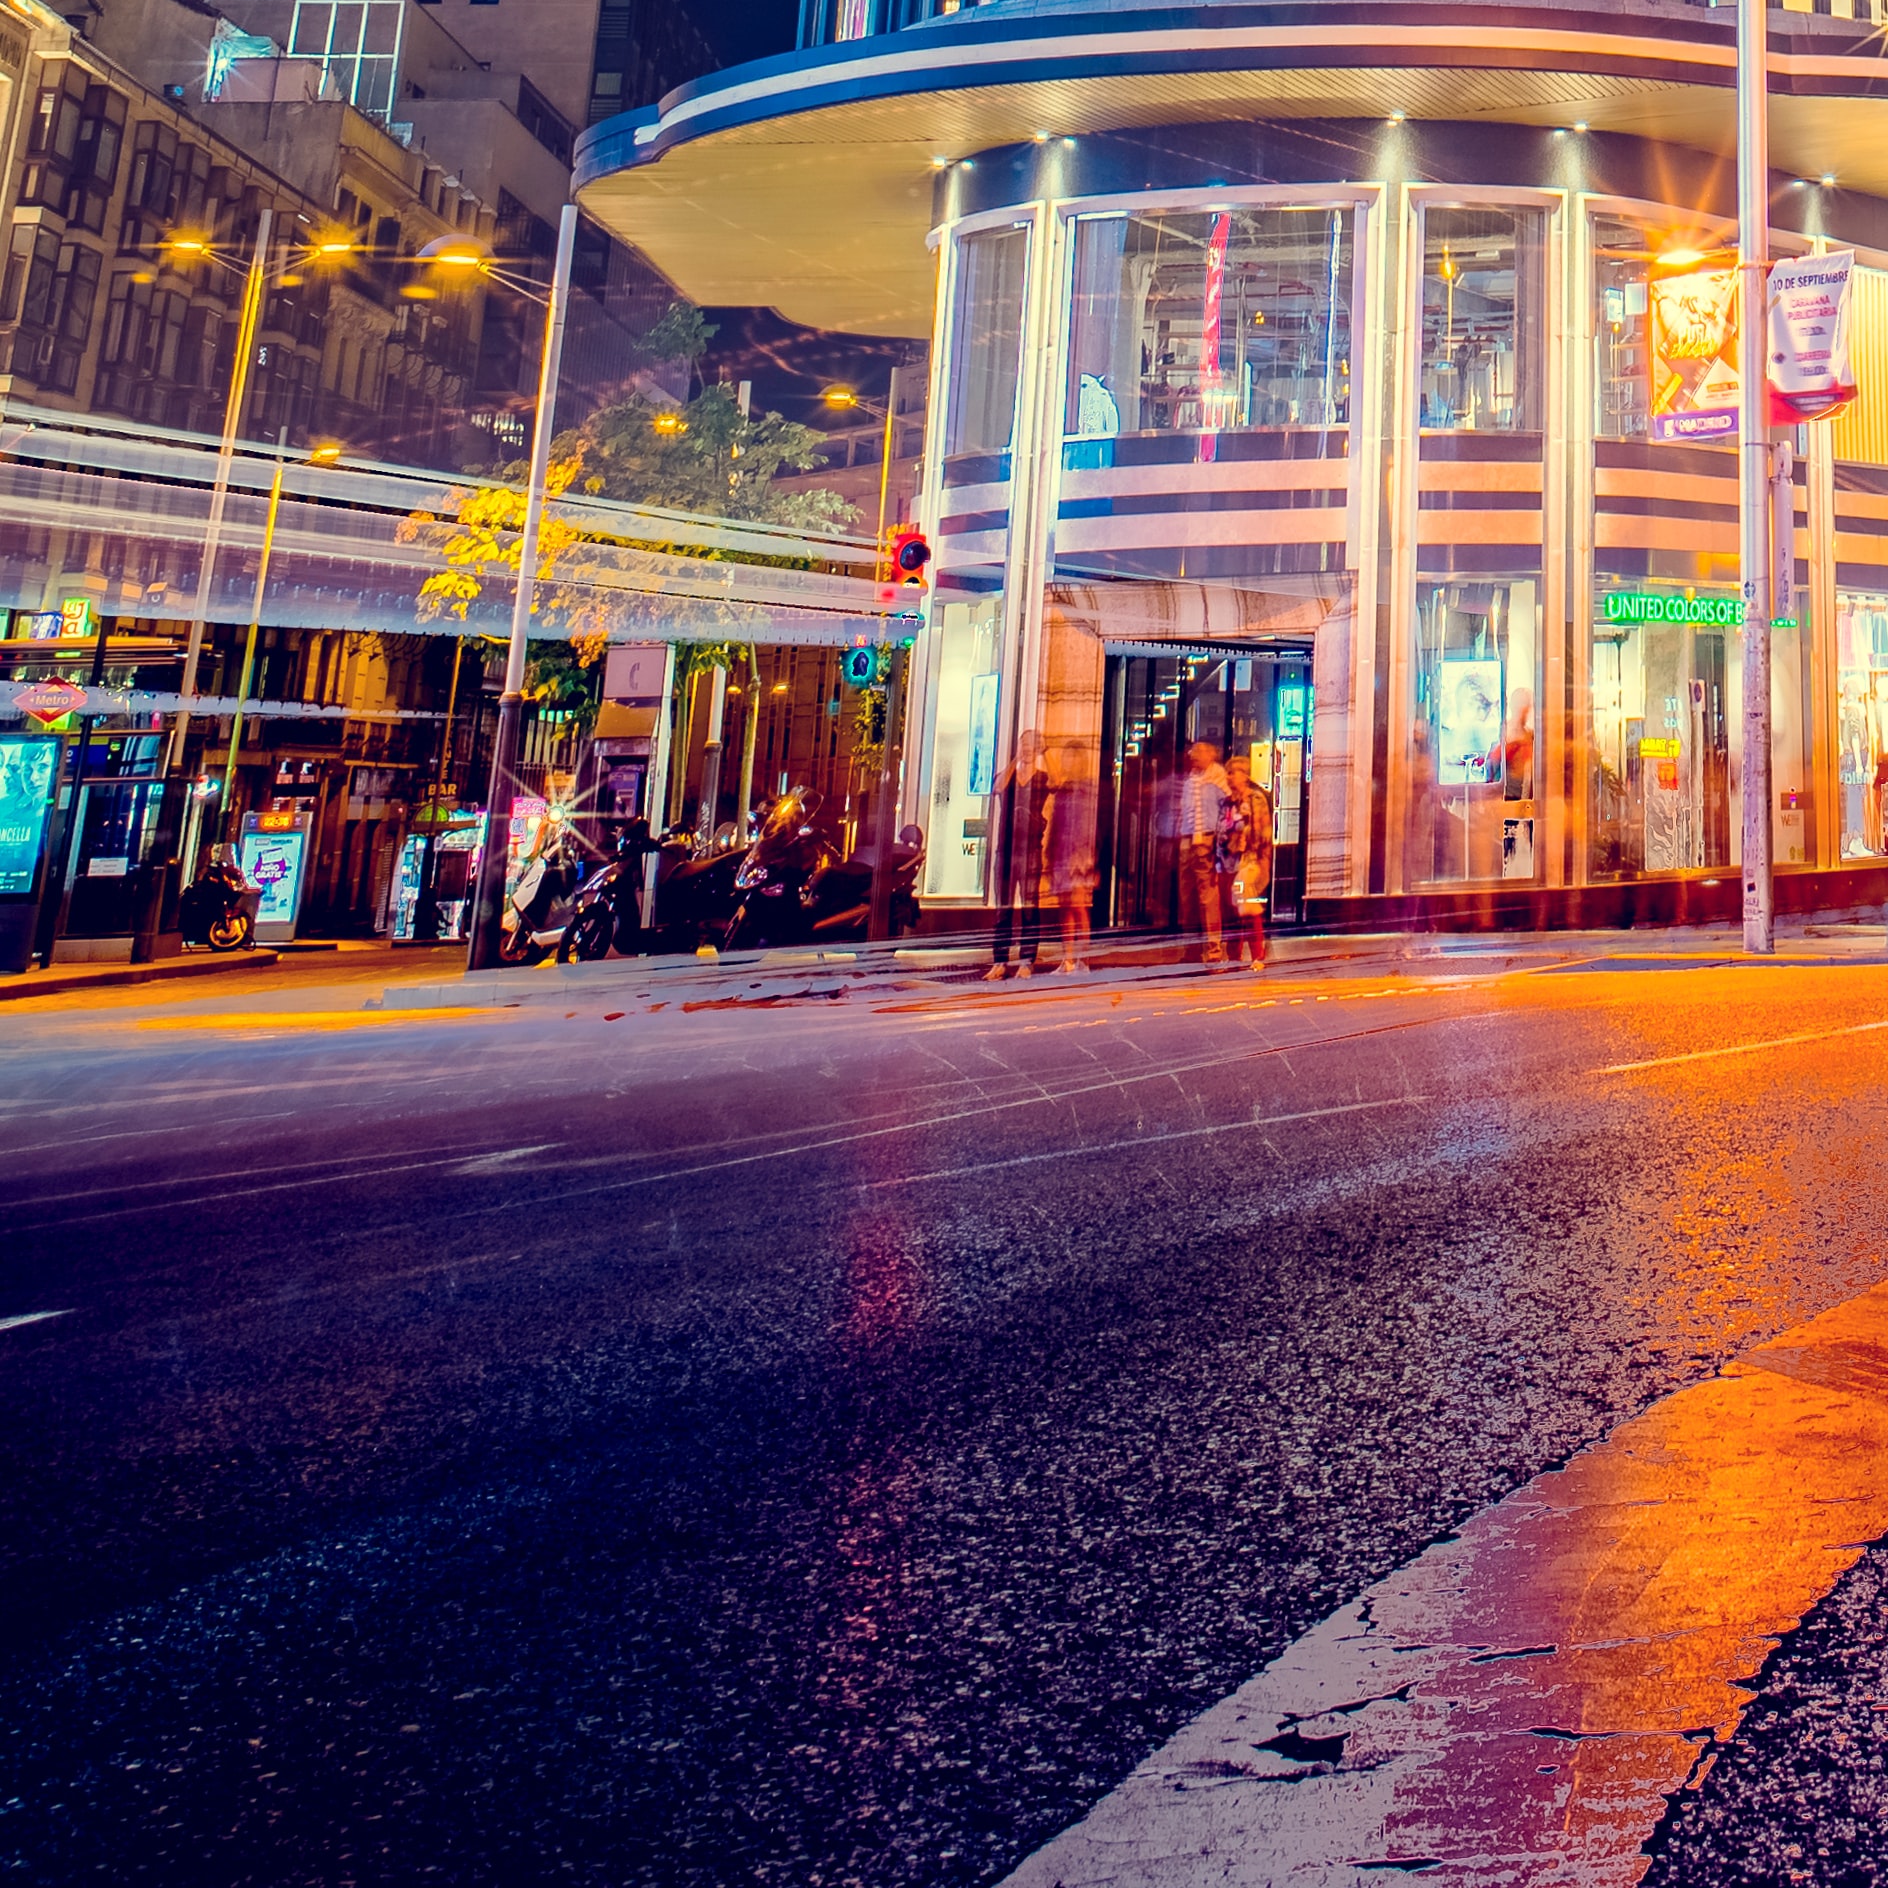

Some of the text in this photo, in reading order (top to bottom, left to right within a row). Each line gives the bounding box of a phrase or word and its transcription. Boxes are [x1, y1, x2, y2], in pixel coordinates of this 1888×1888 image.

[1773, 270, 1849, 291] 10 DE SEPTIEMBRE
[1608, 594, 1663, 619] UNITED
[1665, 597, 1714, 621] COLORS
[1716, 601, 1735, 623] OF
[35, 693, 69, 707] Metro
[427, 783, 457, 796] BAR
